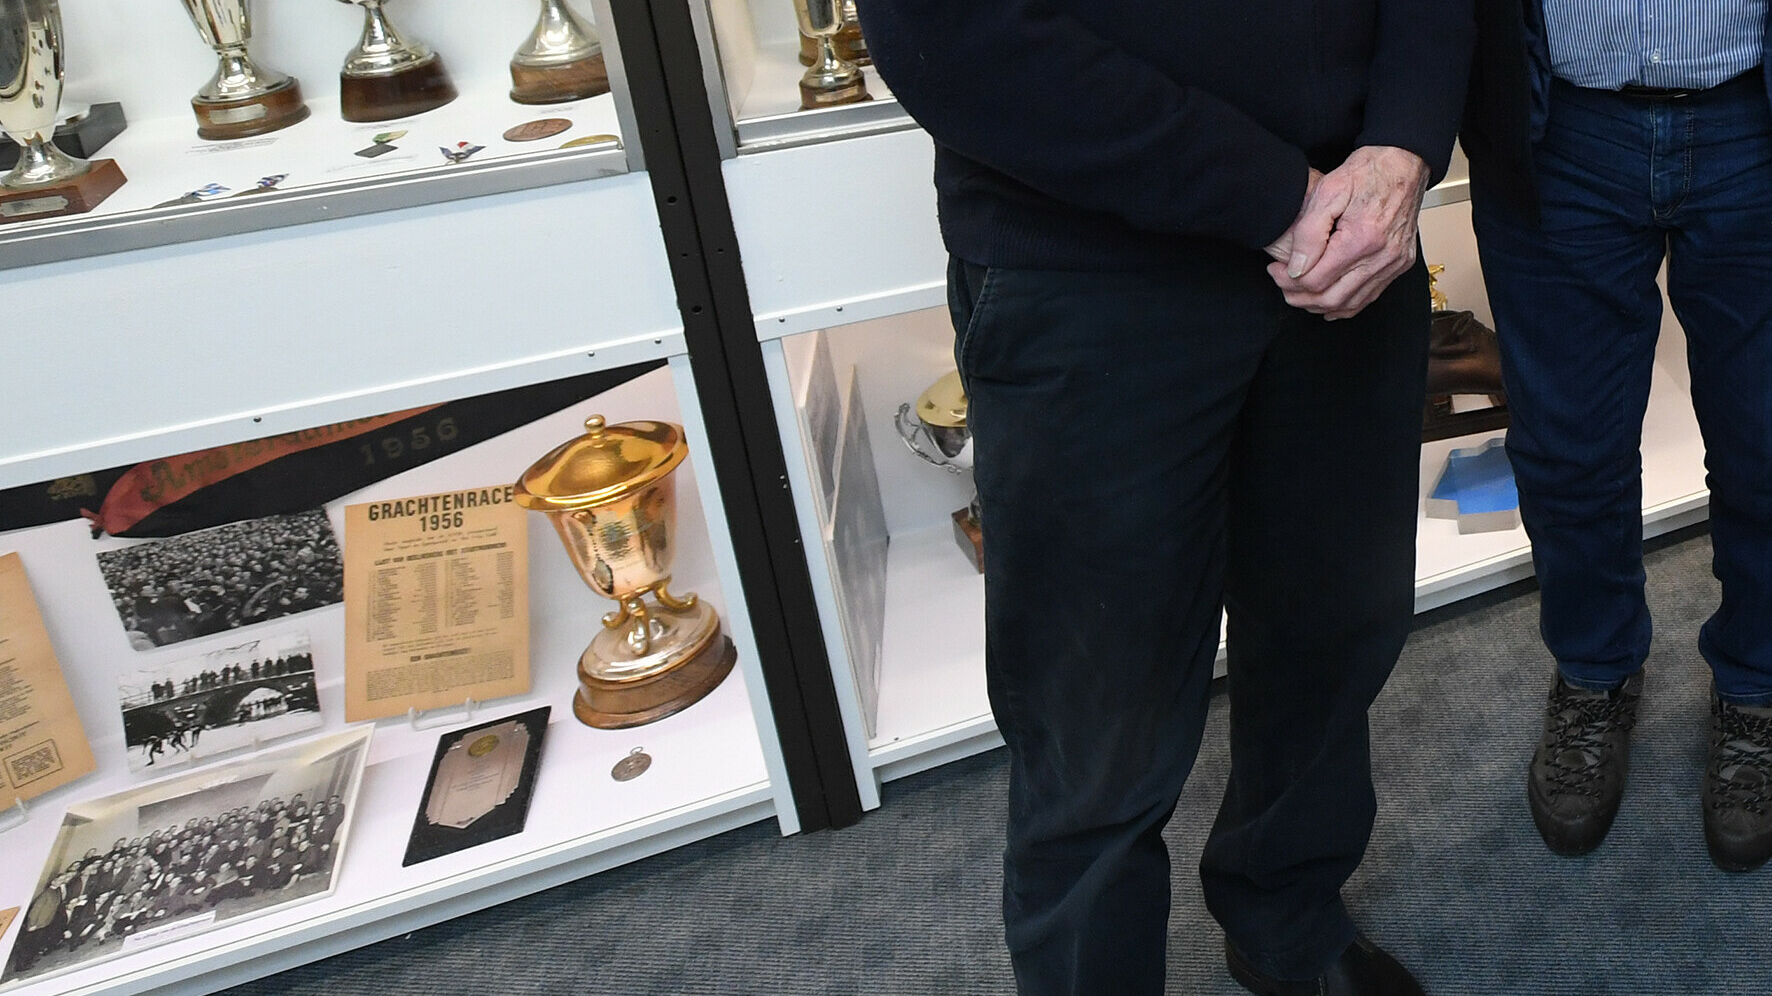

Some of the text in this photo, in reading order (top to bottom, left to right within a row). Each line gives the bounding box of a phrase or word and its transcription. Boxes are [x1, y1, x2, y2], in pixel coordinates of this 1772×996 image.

[359, 416, 459, 467] 1956
[368, 486, 514, 522] GRACHTENRACE
[419, 511, 464, 532] 1956
